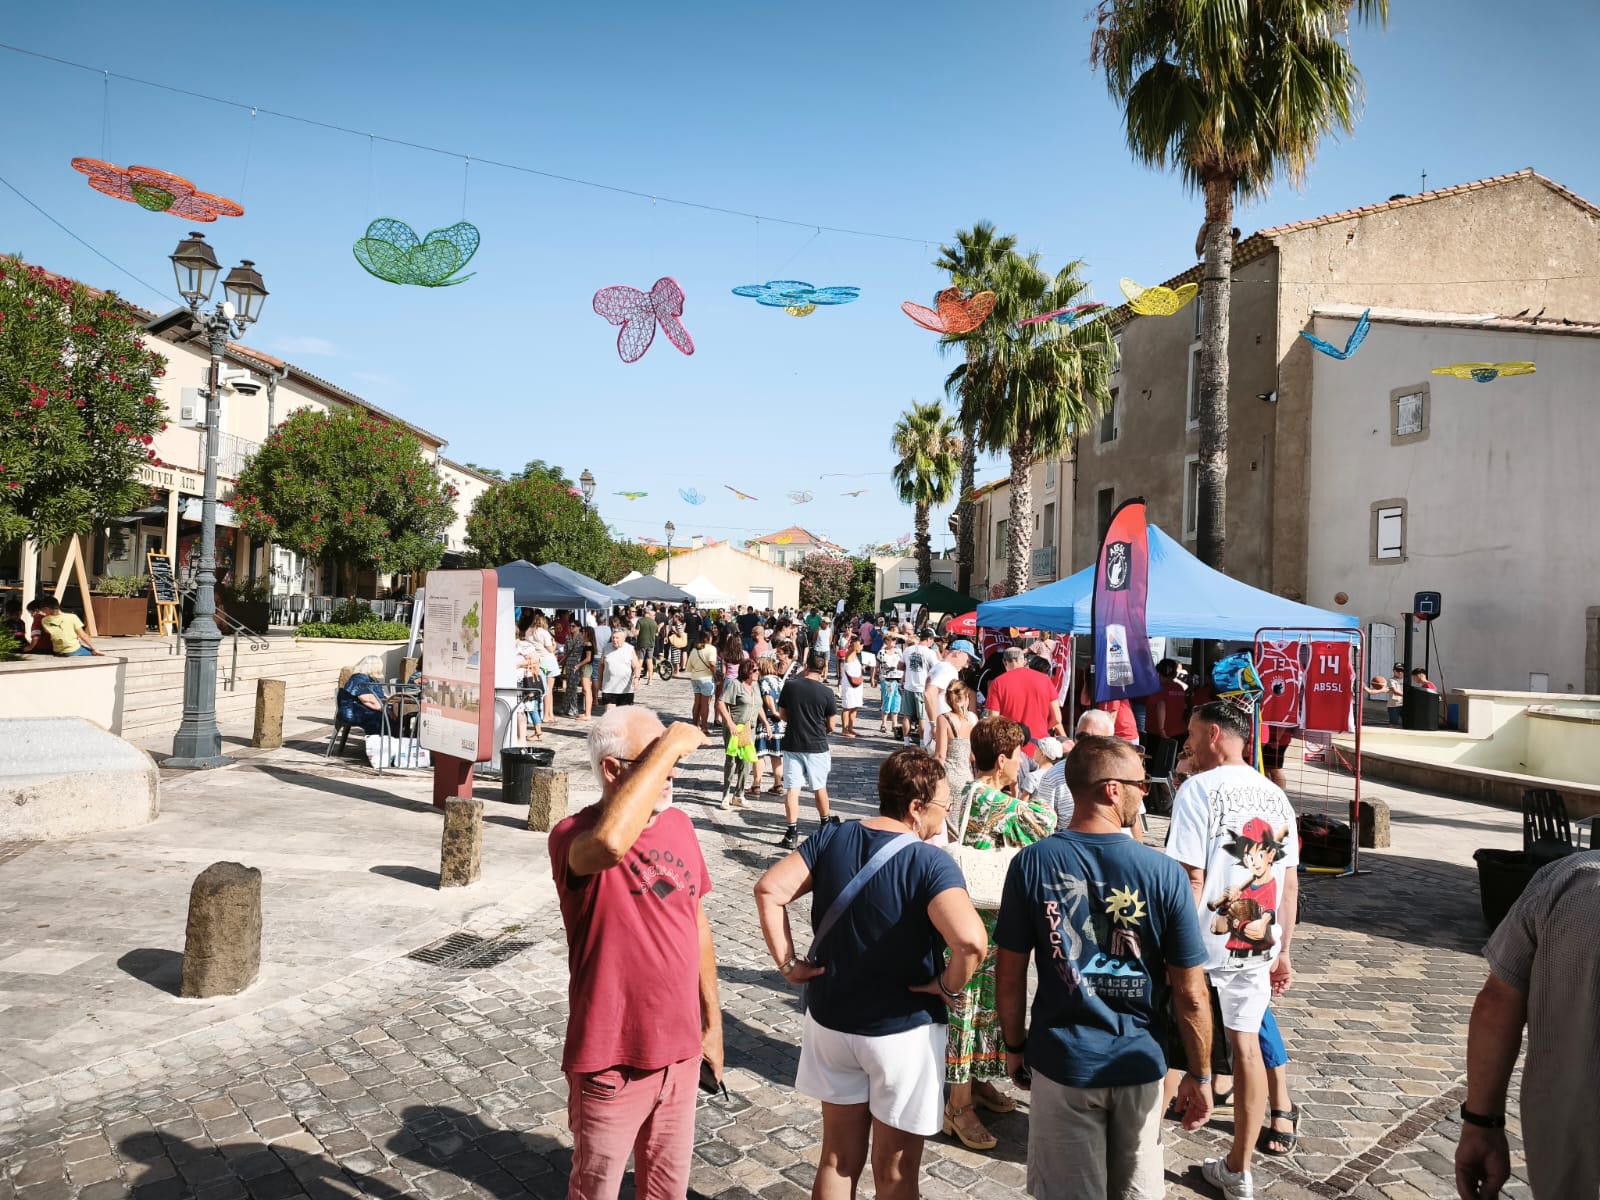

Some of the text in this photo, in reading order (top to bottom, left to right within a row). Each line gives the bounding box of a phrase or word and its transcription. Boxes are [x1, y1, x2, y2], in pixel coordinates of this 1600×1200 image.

[179, 475, 196, 491] AIR
[1273, 658, 1286, 672] 13
[1320, 655, 1340, 675] 14
[1313, 682, 1344, 694] ABSSL
[1043, 900, 1066, 960] RVCA
[1131, 978, 1147, 988] OF
